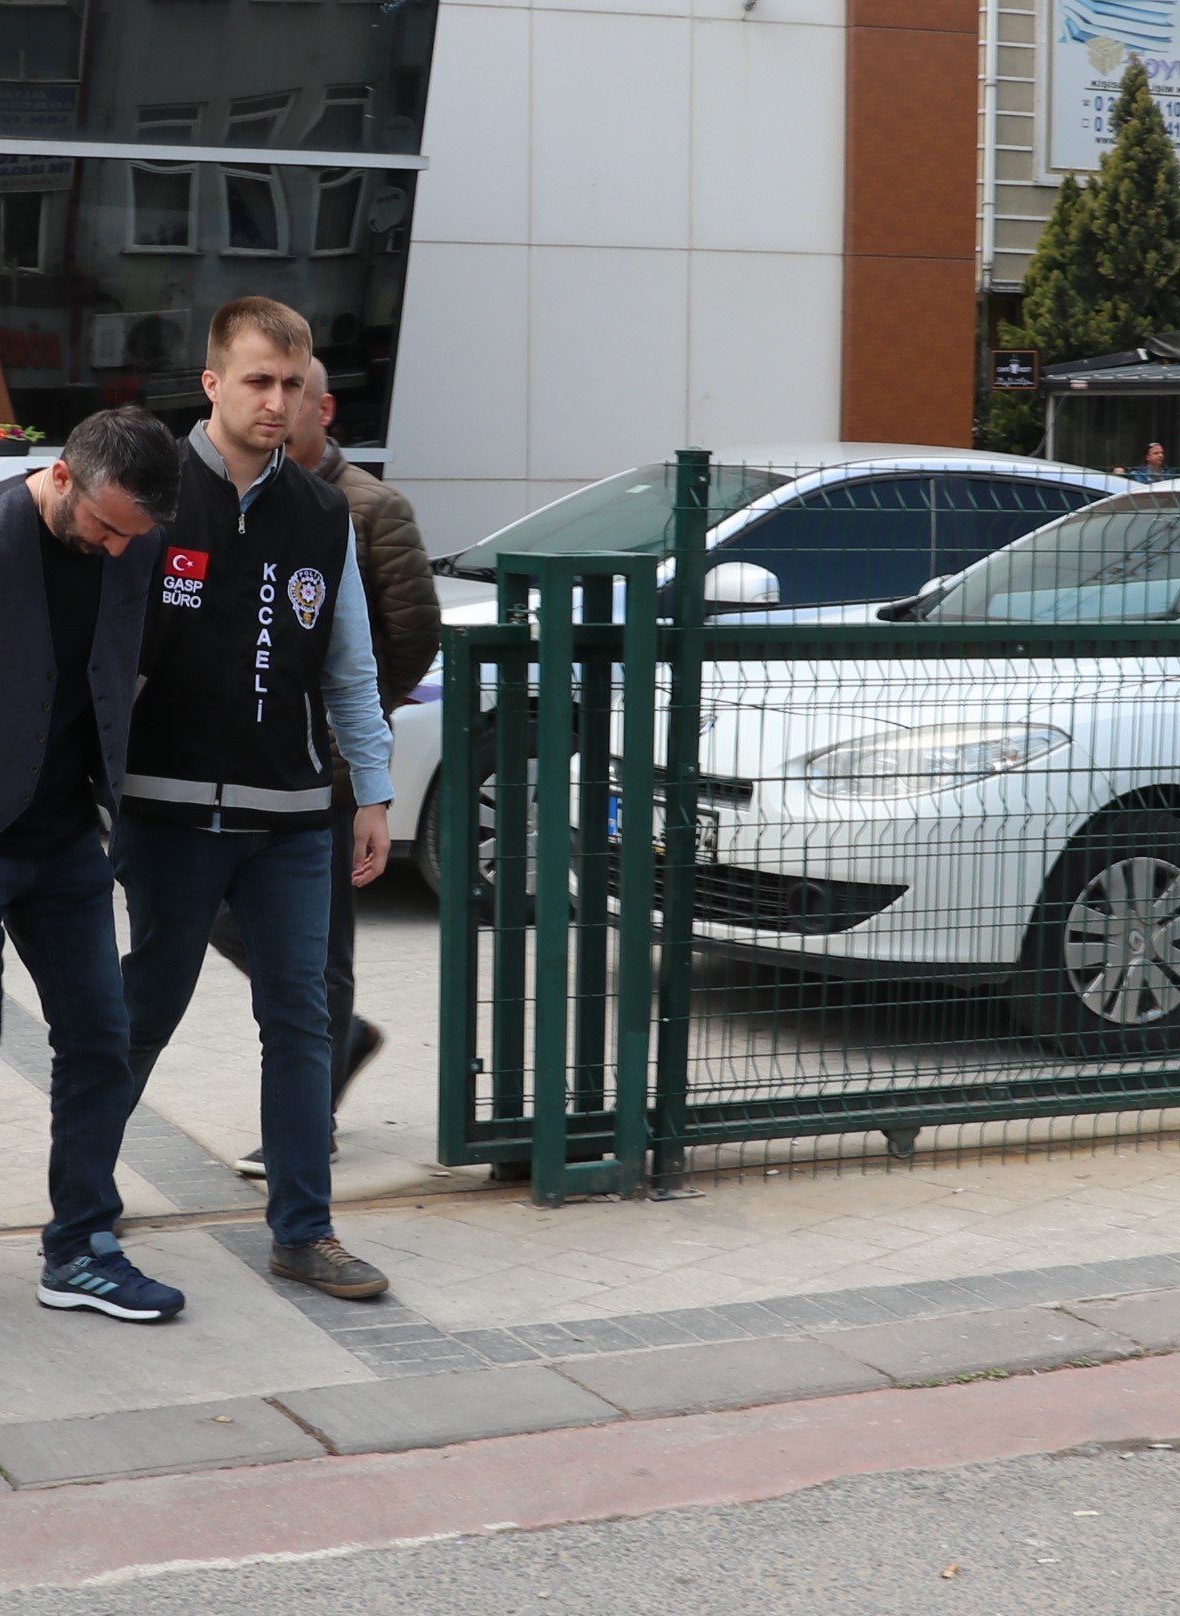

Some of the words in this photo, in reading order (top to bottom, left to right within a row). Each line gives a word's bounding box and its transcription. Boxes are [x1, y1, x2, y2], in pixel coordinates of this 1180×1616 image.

[163, 576, 203, 593] GASP
[162, 590, 202, 609] BÜRO
[254, 562, 278, 722] KOCAELİ
